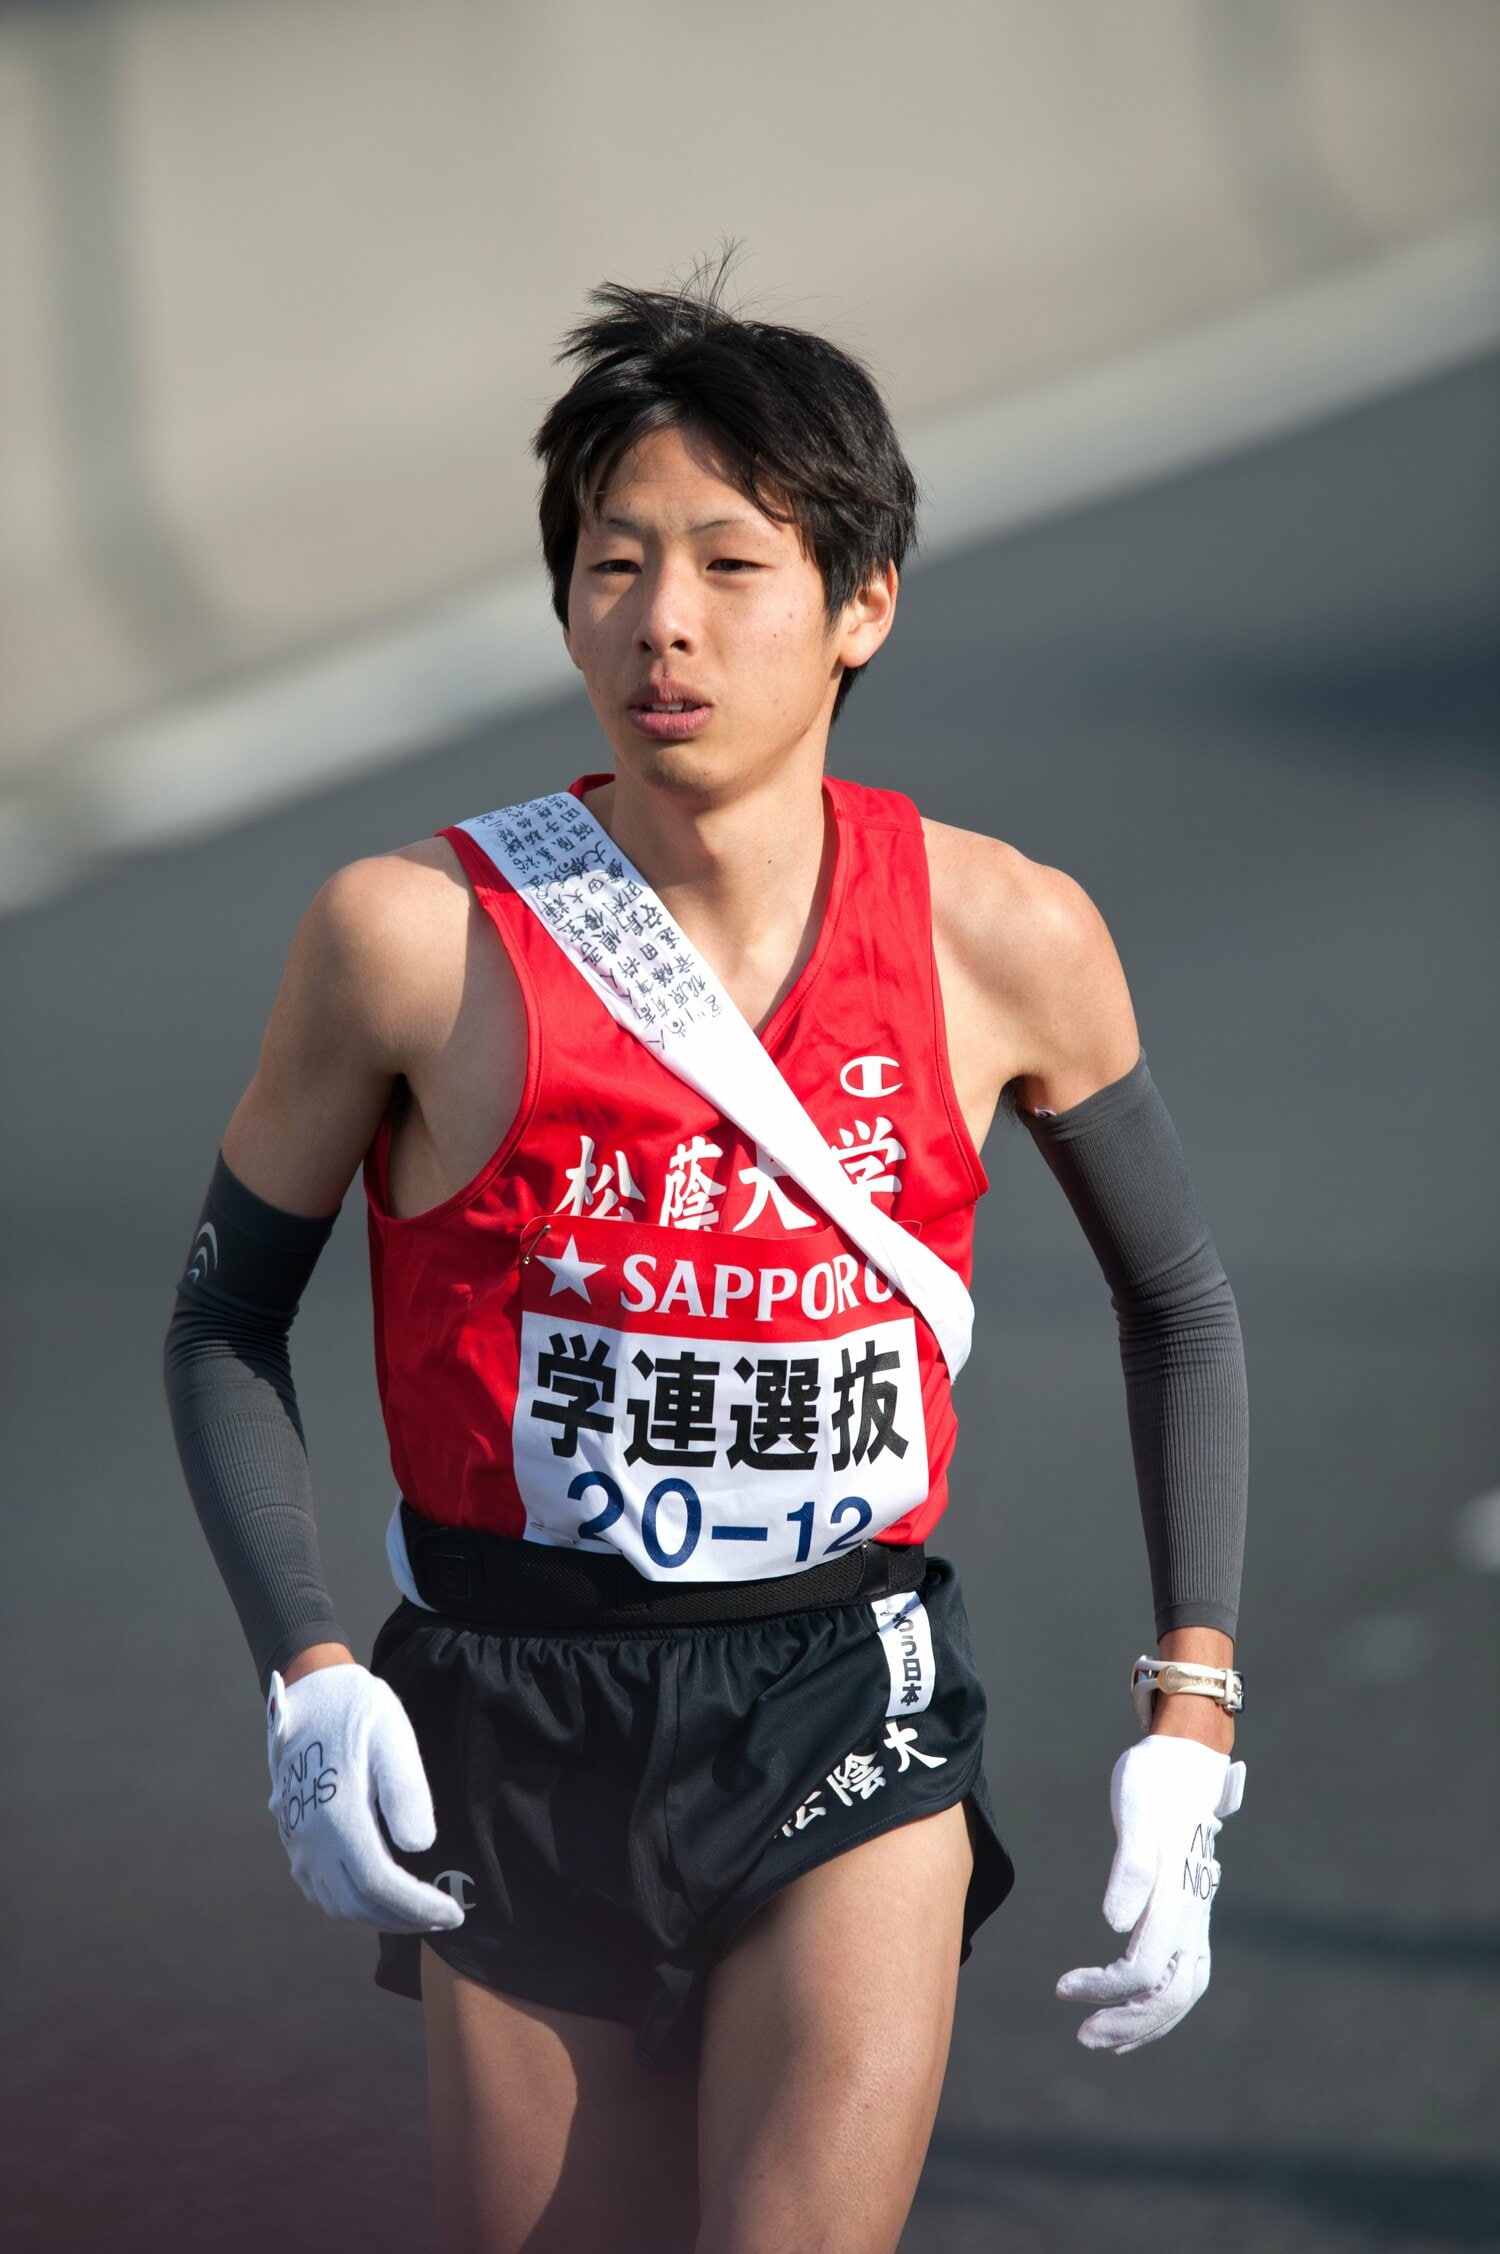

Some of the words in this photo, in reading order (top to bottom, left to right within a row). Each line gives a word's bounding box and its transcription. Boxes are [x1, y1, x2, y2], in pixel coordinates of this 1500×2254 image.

[530, 1332, 910, 1473] 学連選抜
[567, 1470, 873, 1569] 20-12
